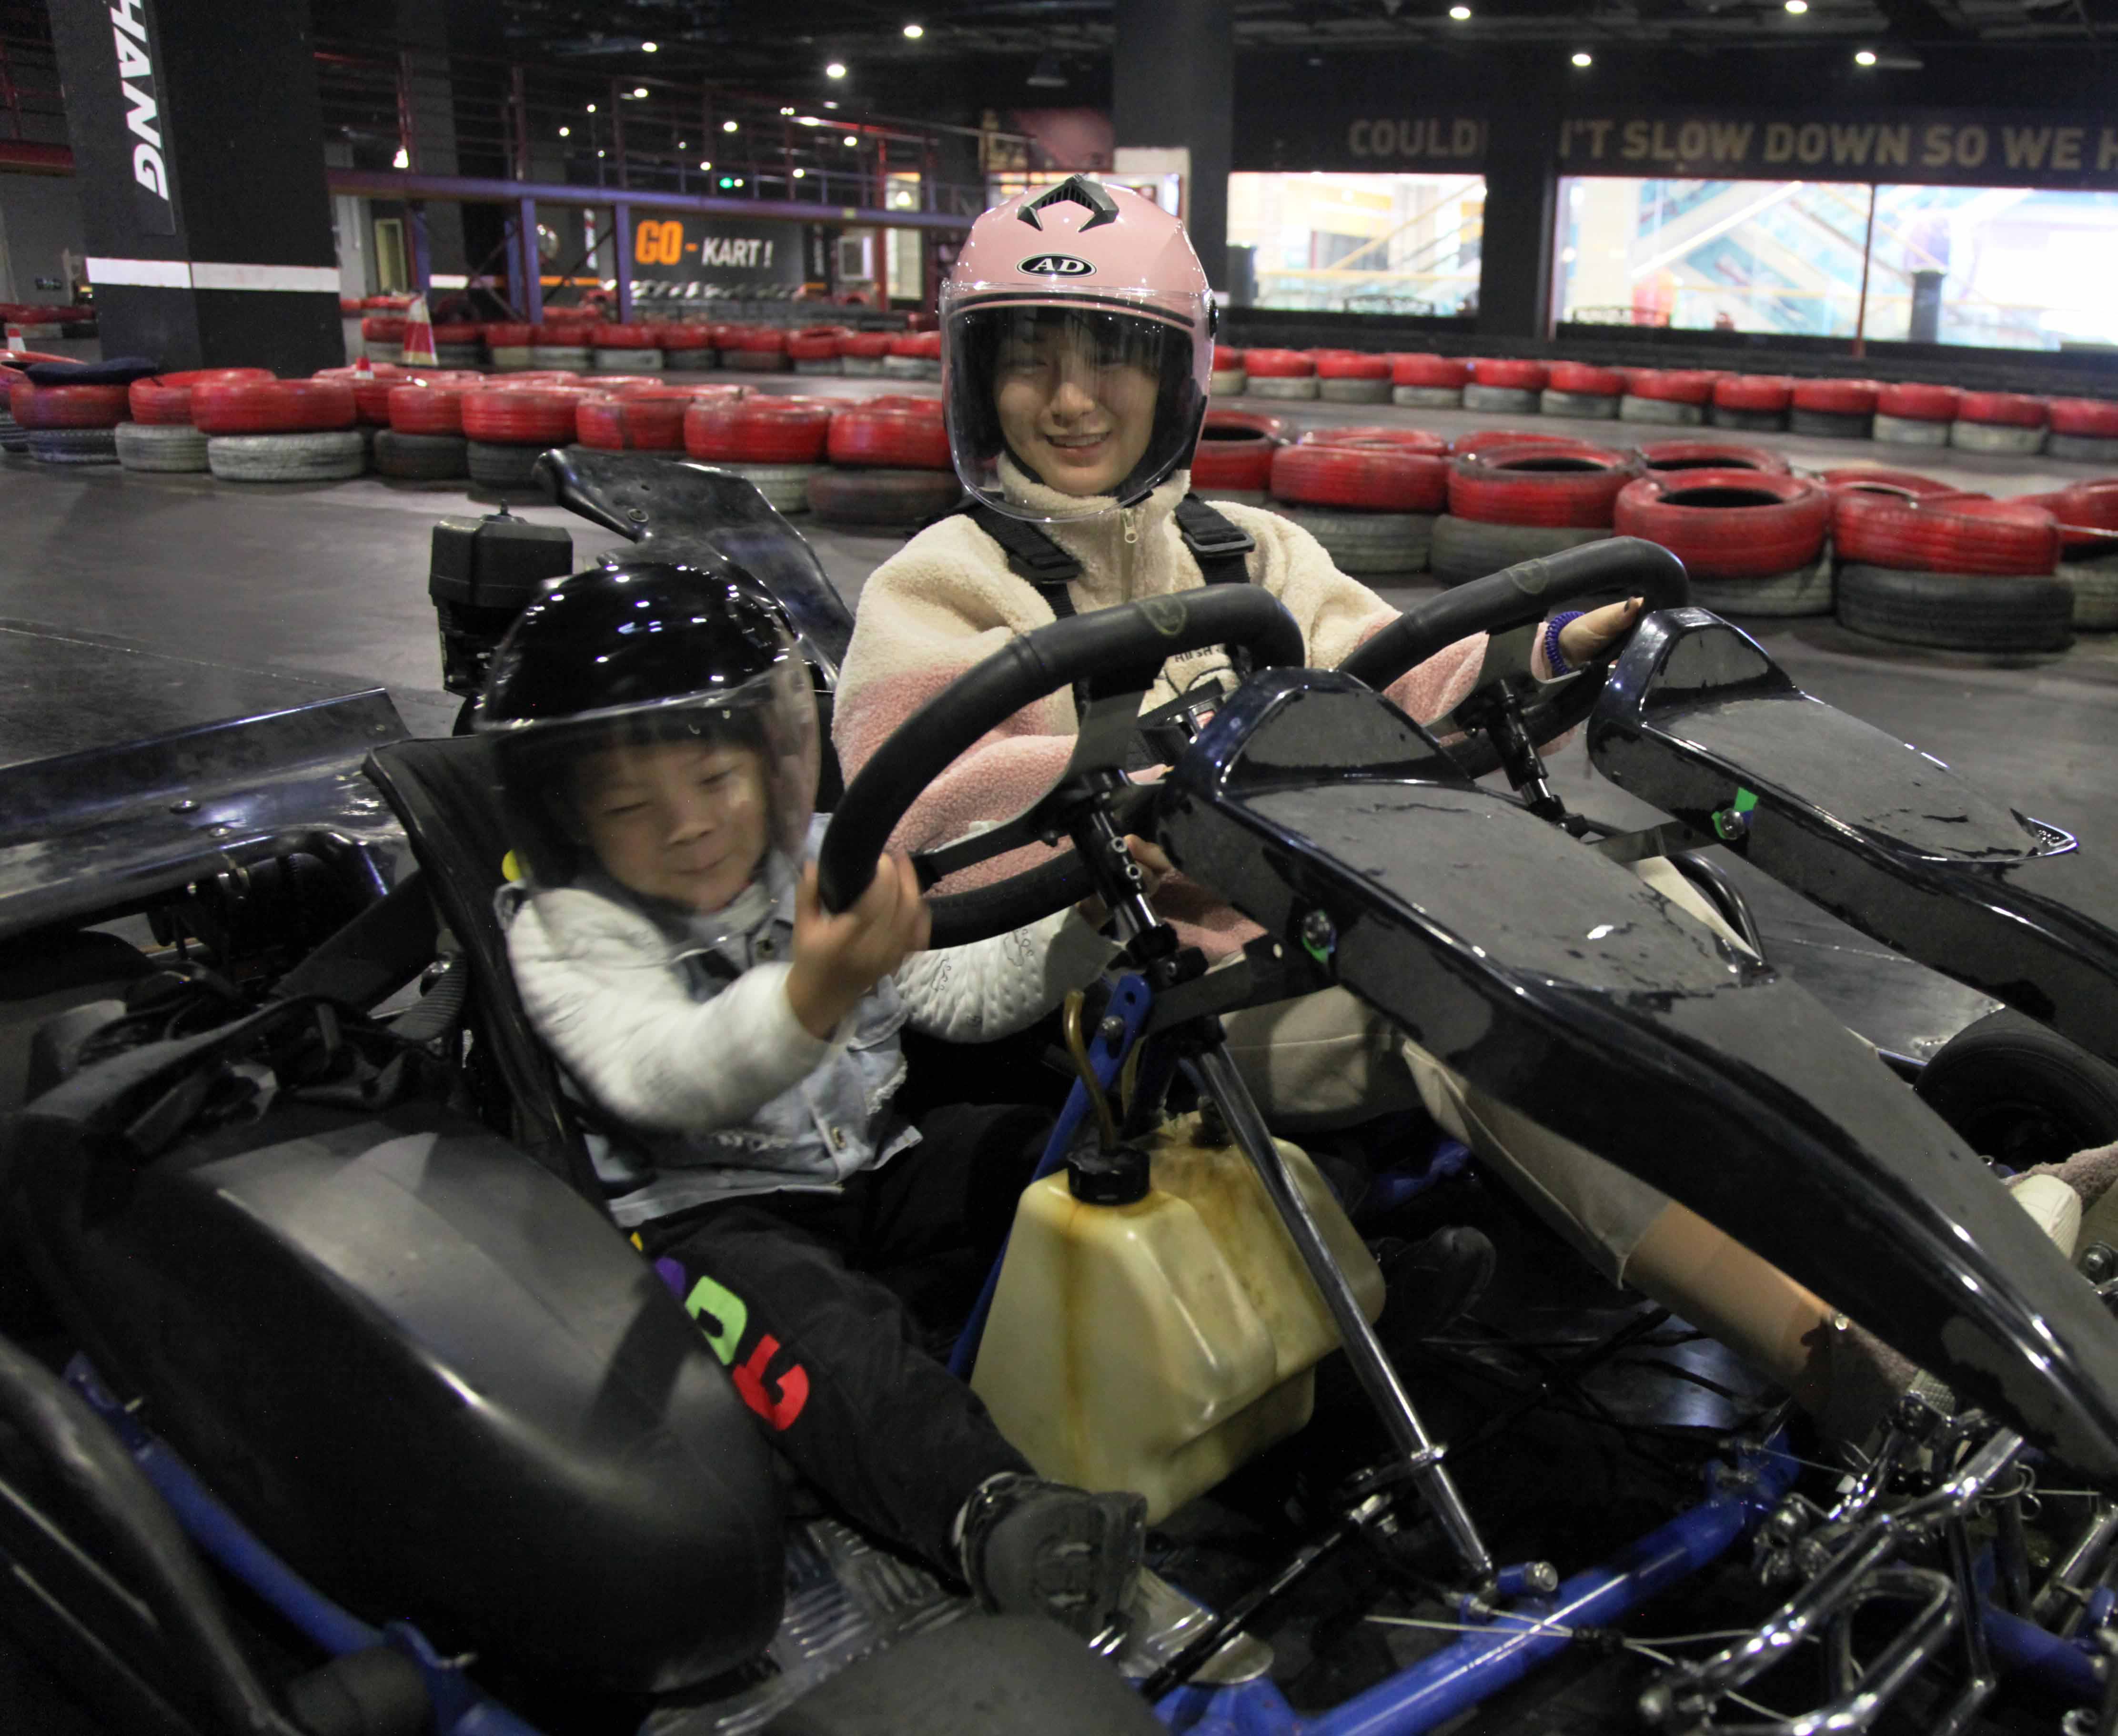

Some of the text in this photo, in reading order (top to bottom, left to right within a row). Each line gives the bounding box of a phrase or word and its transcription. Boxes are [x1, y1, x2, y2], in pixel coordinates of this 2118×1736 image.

[1622, 120, 1755, 162] SLOW
[1765, 122, 1910, 165] DOWN
[1922, 124, 1988, 168] SO
[2003, 126, 2085, 170] WE
[1029, 258, 1085, 273] AD
